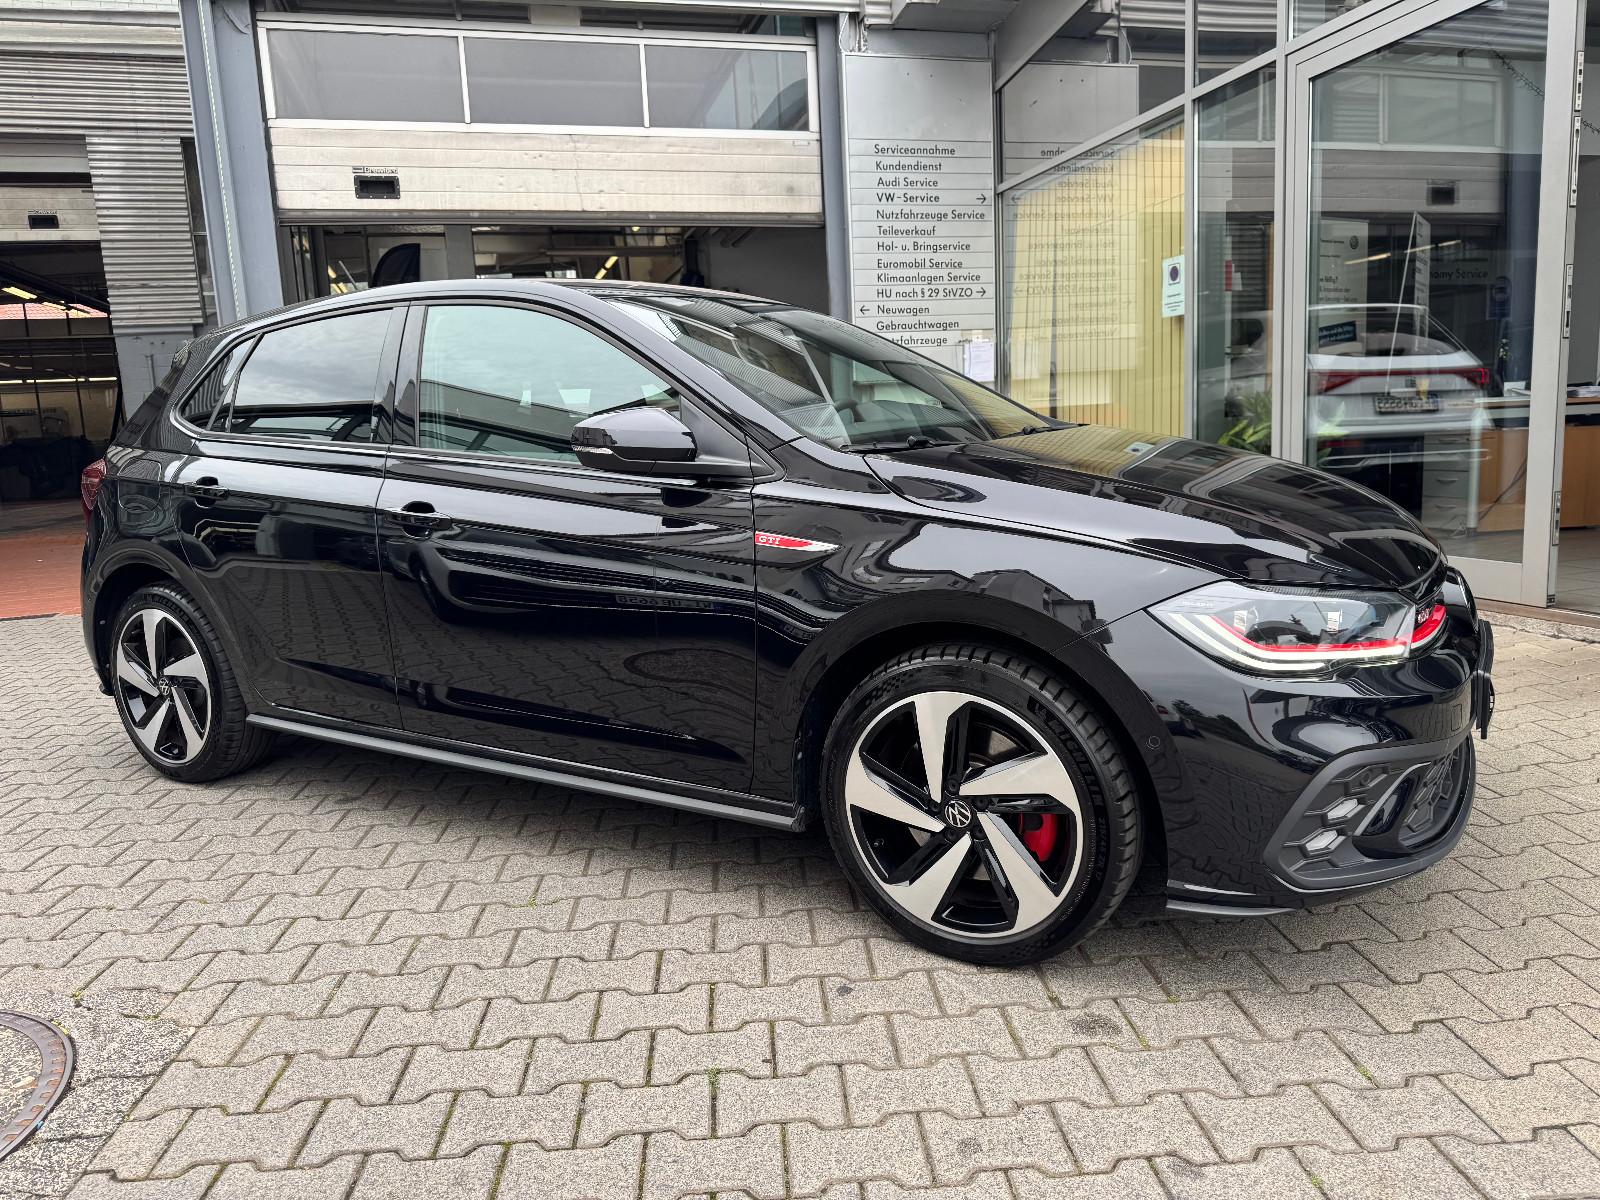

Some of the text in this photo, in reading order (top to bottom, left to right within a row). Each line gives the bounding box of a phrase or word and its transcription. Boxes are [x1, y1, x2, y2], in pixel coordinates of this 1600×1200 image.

[874, 144, 956, 156] Serviceannahme
[875, 161, 942, 171] Kundendienst
[877, 177, 938, 188] Audi Service
[876, 192, 940, 203] VW-Service
[876, 209, 985, 222] Nutzfahrzeuge Service
[877, 225, 936, 236] Teileverkauf
[877, 241, 971, 253] Hol- u. Bringservice
[877, 258, 963, 269] Euromobil Service
[877, 272, 981, 285] Klimaanlagen Service
[876, 287, 973, 299] HU nach § 29 StVZO
[877, 304, 930, 316] Neuwagen
[876, 320, 960, 332] Gebrauchtwagen
[758, 535, 780, 545] GTI
